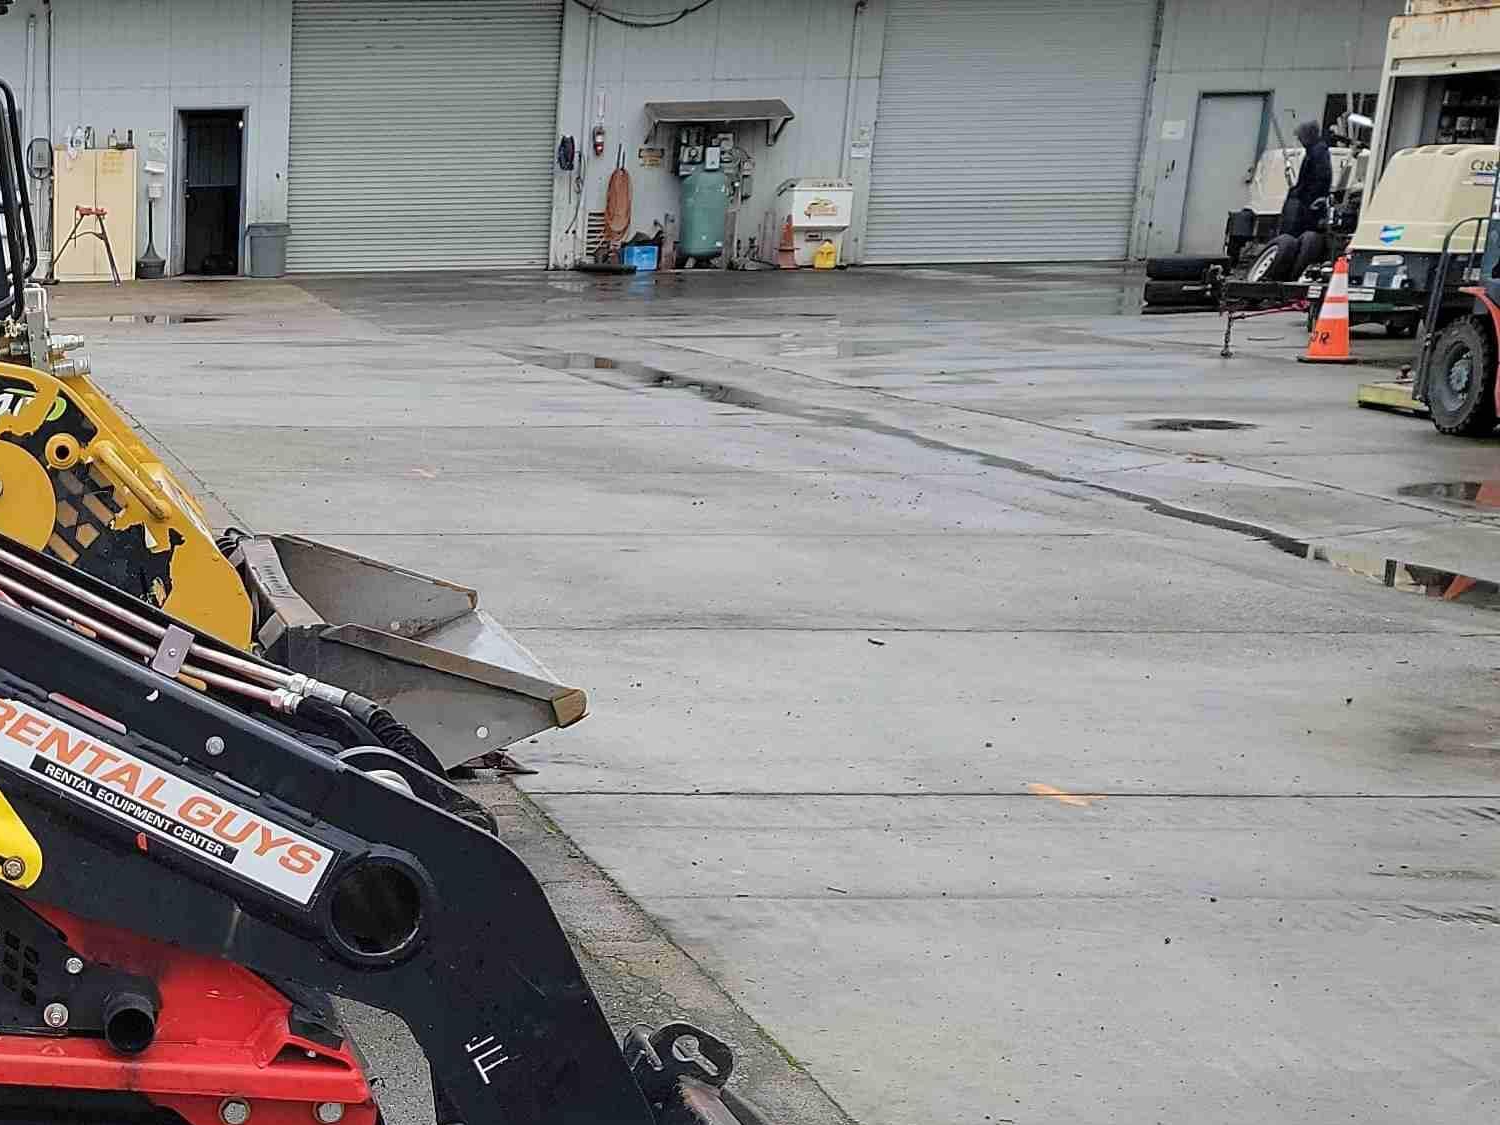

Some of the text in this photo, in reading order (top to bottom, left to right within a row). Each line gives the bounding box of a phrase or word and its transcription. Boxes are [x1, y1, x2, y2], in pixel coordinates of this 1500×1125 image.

[44, 762, 225, 857] RENTAL EQUIPMENT CENTER
[178, 796, 322, 875] GUYS
